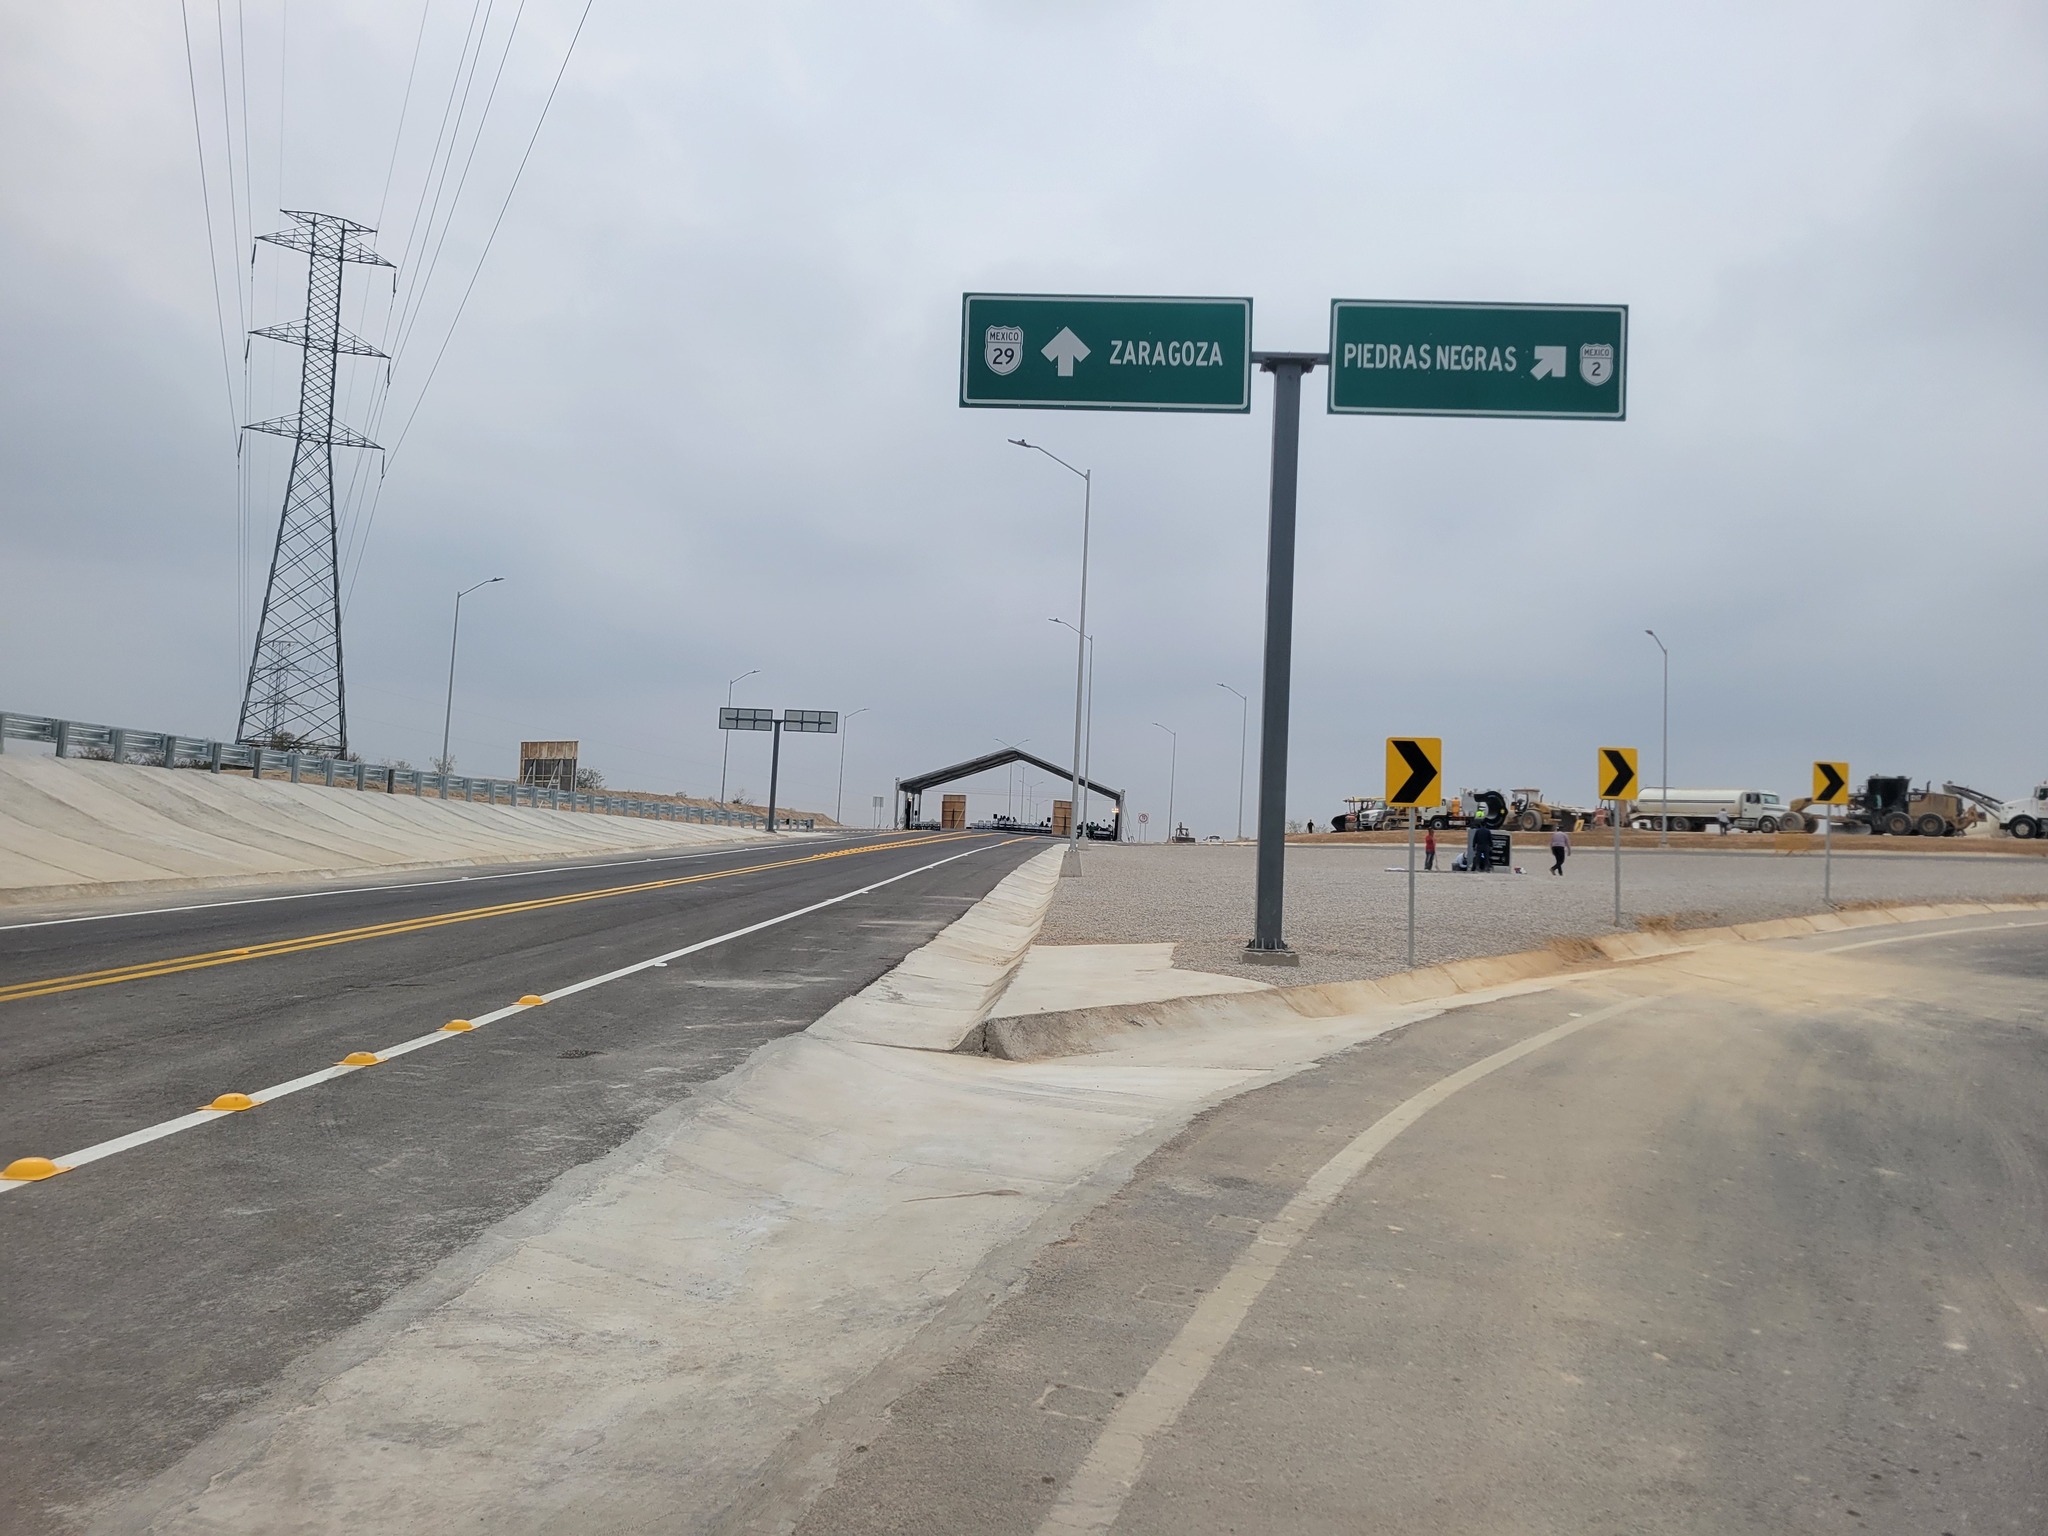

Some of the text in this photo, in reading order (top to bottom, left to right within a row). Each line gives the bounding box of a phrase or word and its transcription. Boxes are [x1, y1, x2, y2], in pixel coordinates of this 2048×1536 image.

[990, 331, 1019, 341] MEXICO
[993, 347, 1015, 365] 29
[1109, 340, 1223, 367] ZARAGOZA
[1344, 343, 1517, 372] PIEDRAS NEGRAS
[1584, 348, 1610, 357] MEXICO
[1591, 361, 1602, 377] 2
